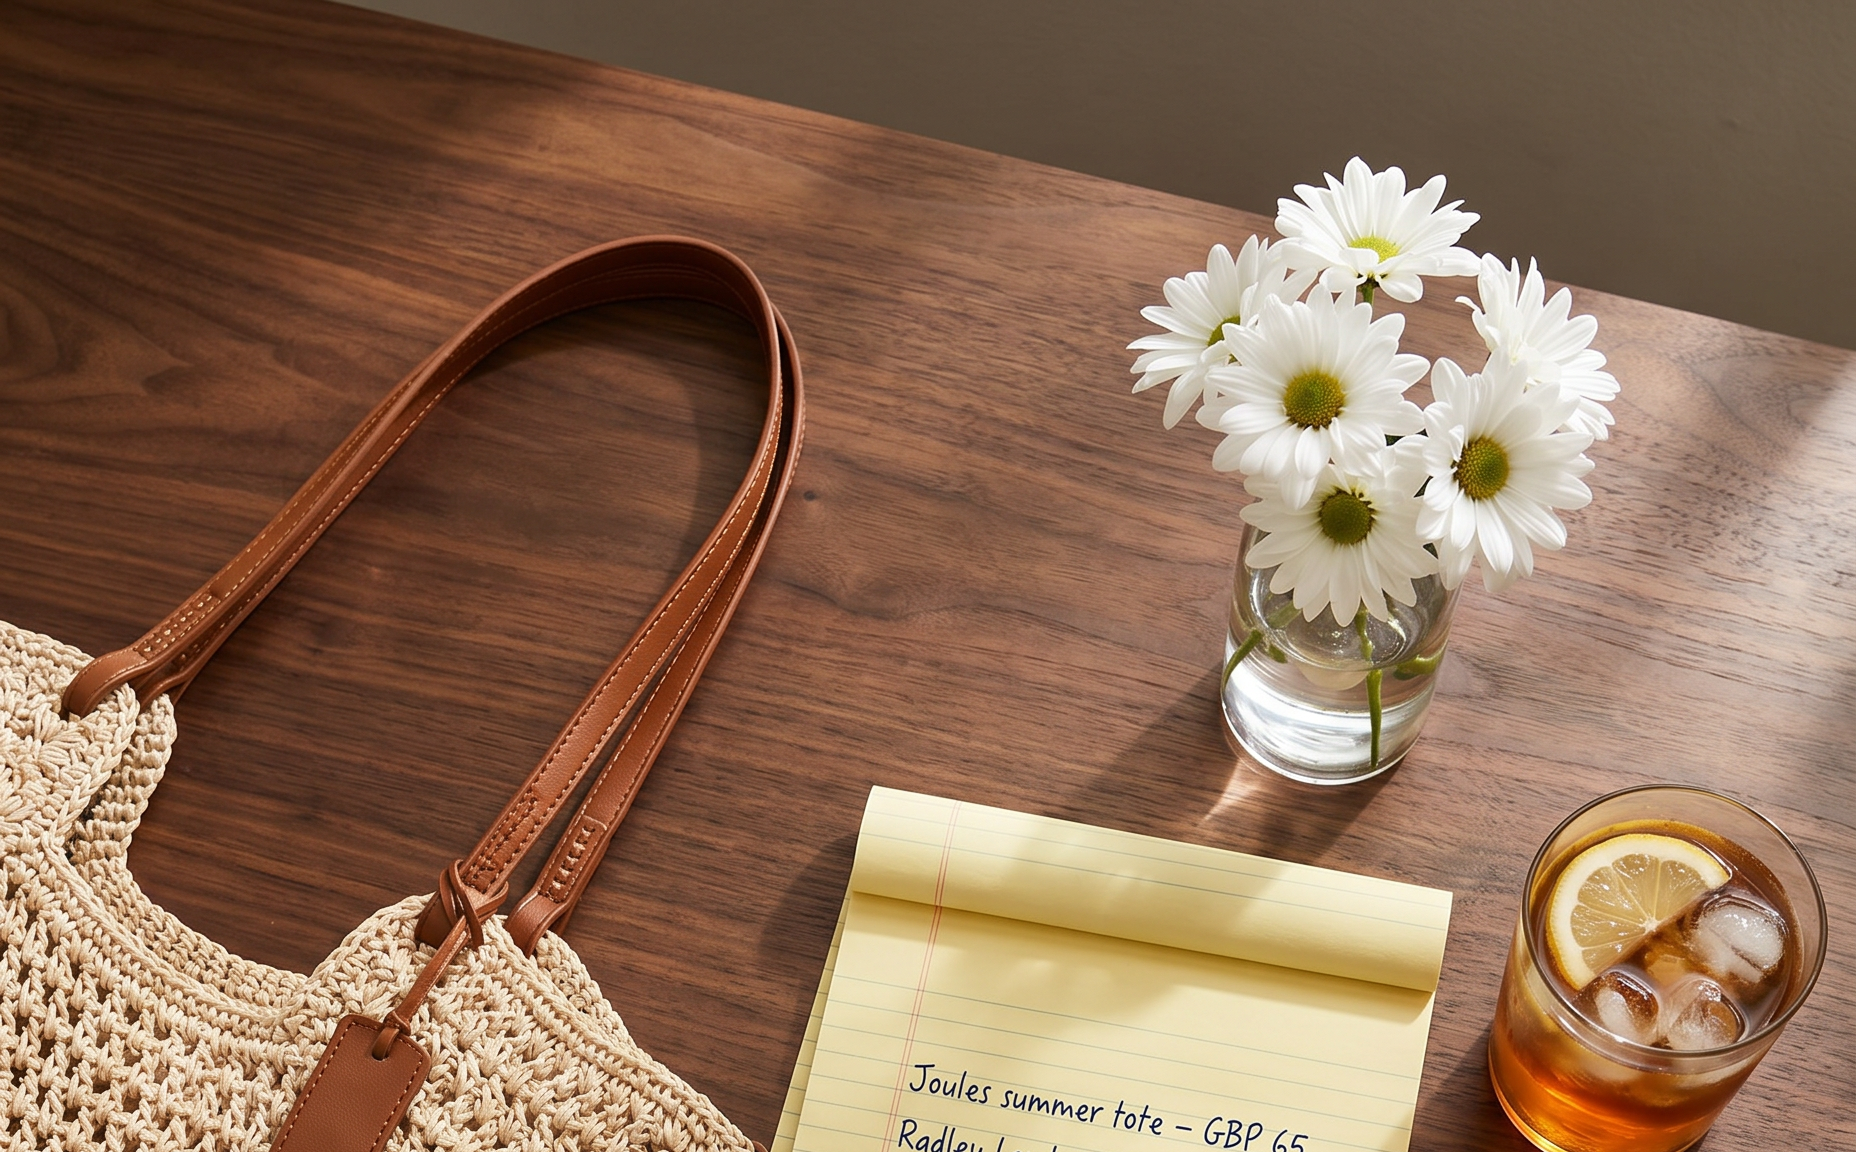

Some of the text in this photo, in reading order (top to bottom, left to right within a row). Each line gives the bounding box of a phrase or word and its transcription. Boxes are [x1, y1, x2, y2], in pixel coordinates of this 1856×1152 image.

[909, 1063, 991, 1105] Joules
[1000, 1089, 1105, 1123] summer
[1112, 1100, 1164, 1137] tote
[1203, 1115, 1265, 1152] GBP
